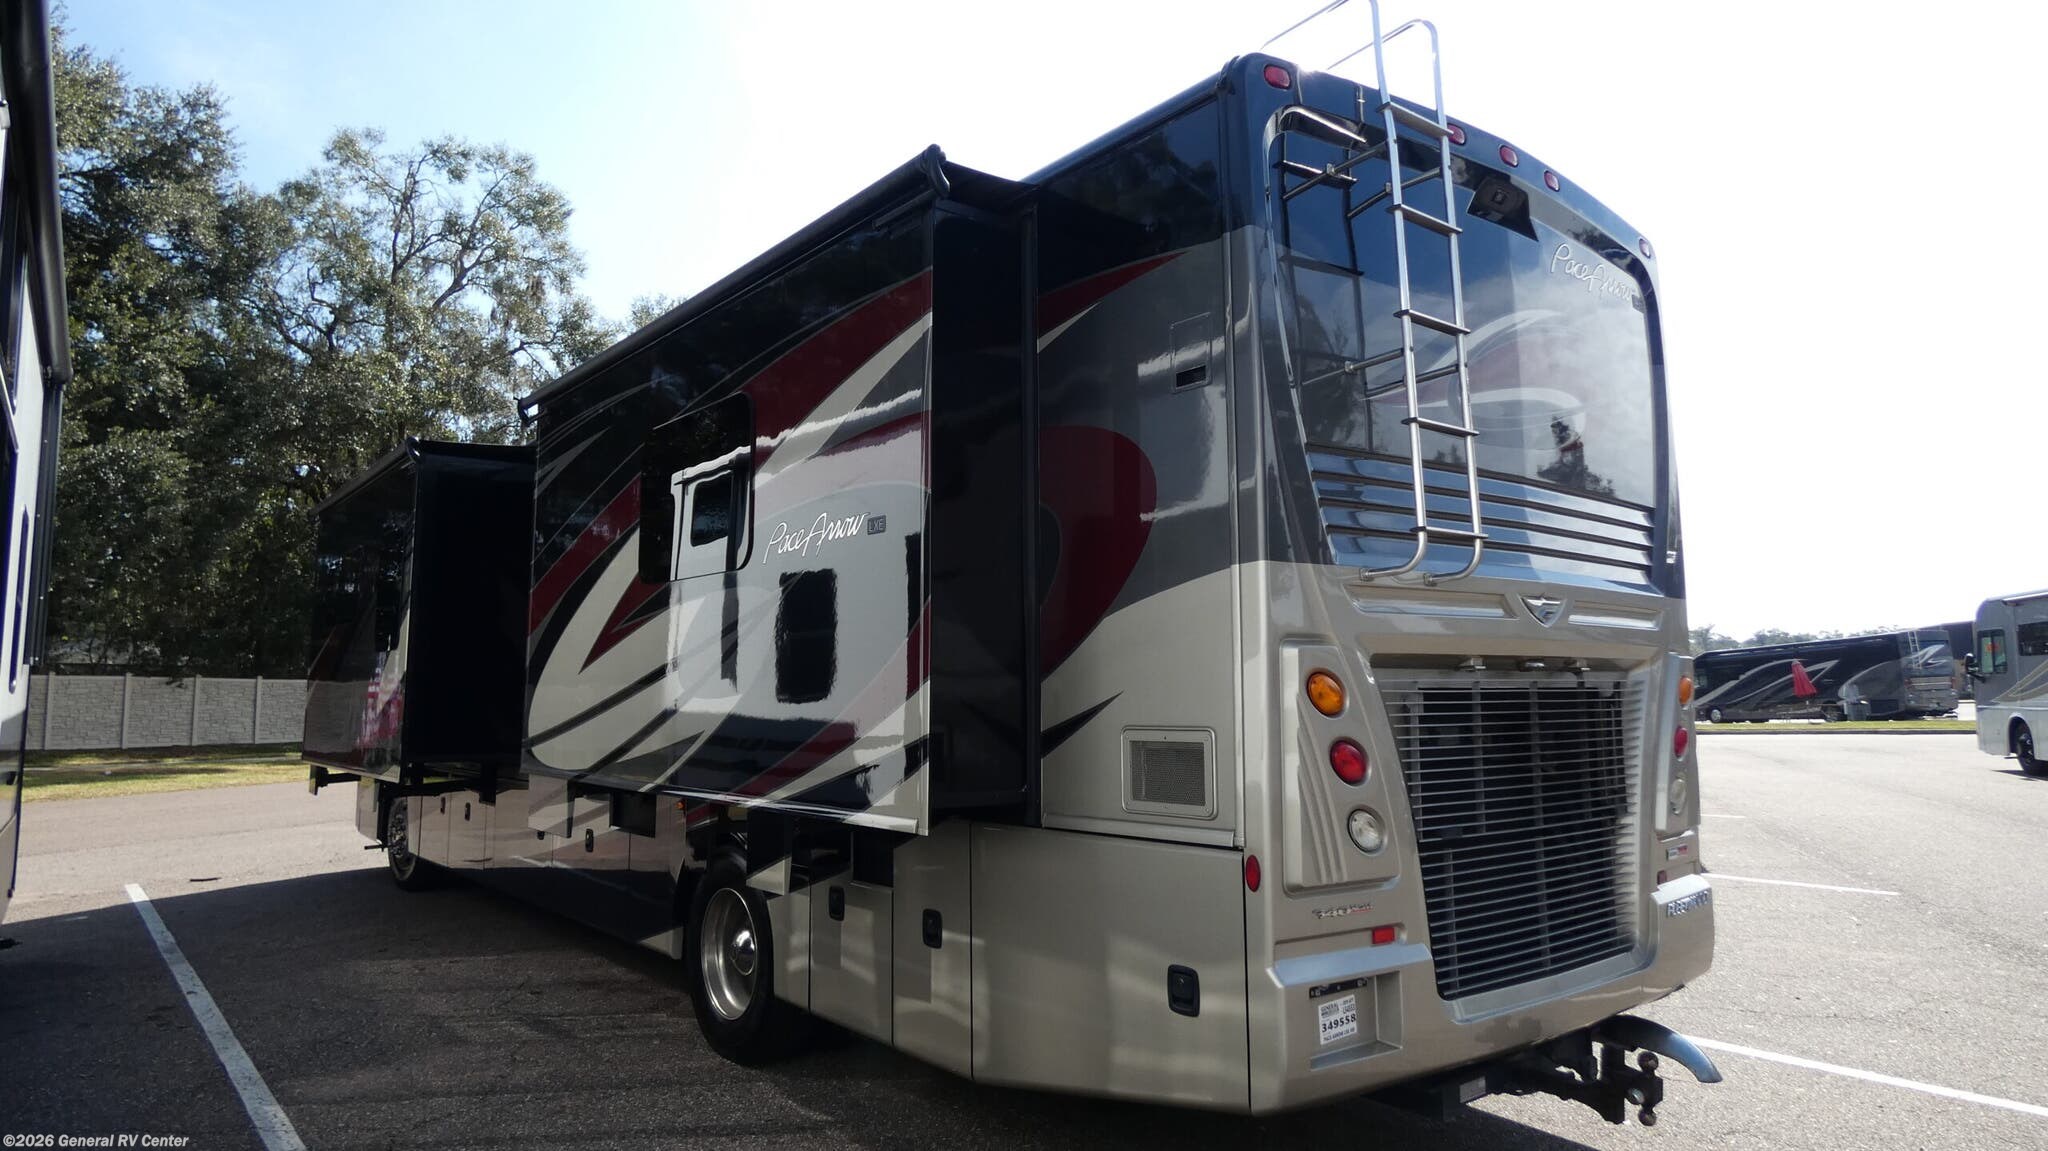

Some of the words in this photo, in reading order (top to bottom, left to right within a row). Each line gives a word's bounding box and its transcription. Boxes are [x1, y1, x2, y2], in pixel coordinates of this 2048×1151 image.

[1550, 243, 1589, 279] Pace
[762, 521, 804, 564] Pace
[800, 512, 871, 558] Arrow
[868, 517, 885, 533] LXE
[1321, 1013, 1357, 1033] 349558
